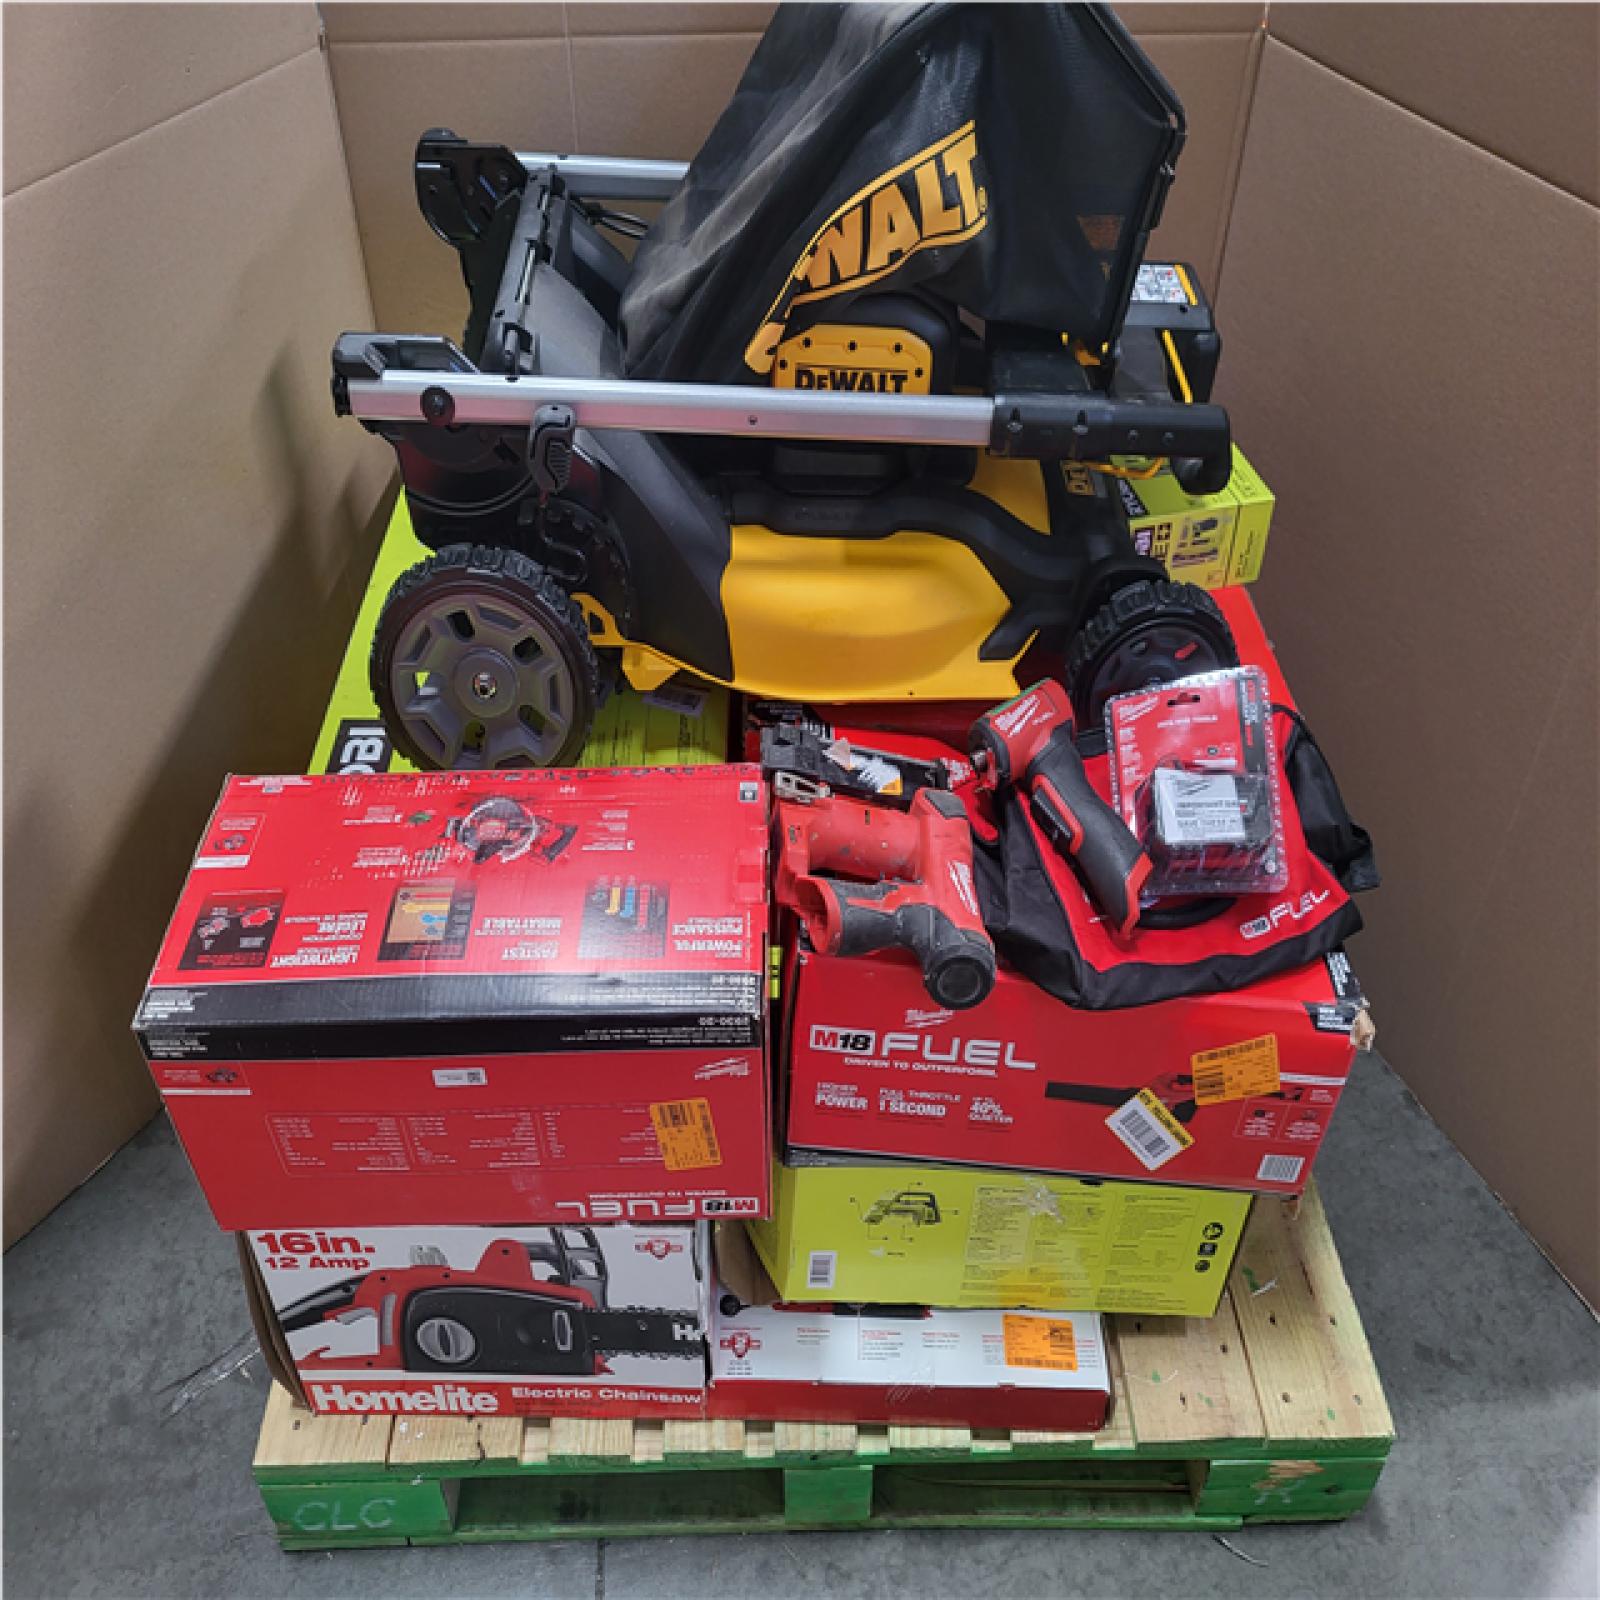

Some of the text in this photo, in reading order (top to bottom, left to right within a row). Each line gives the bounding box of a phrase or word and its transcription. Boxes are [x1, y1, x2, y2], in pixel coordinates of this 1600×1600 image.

[1270, 889, 1331, 929] FUEL
[809, 1024, 1037, 1070] M18 FUEL
[815, 1092, 869, 1111] POWER
[889, 1101, 946, 1117] SECOND
[554, 1197, 760, 1218] M18 FUEL
[256, 1231, 376, 1255] 16in.
[264, 1256, 371, 1272] 12 Amp
[310, 1383, 702, 1414] Homelite Electric Chainsaw
[293, 1498, 397, 1531] CLC
